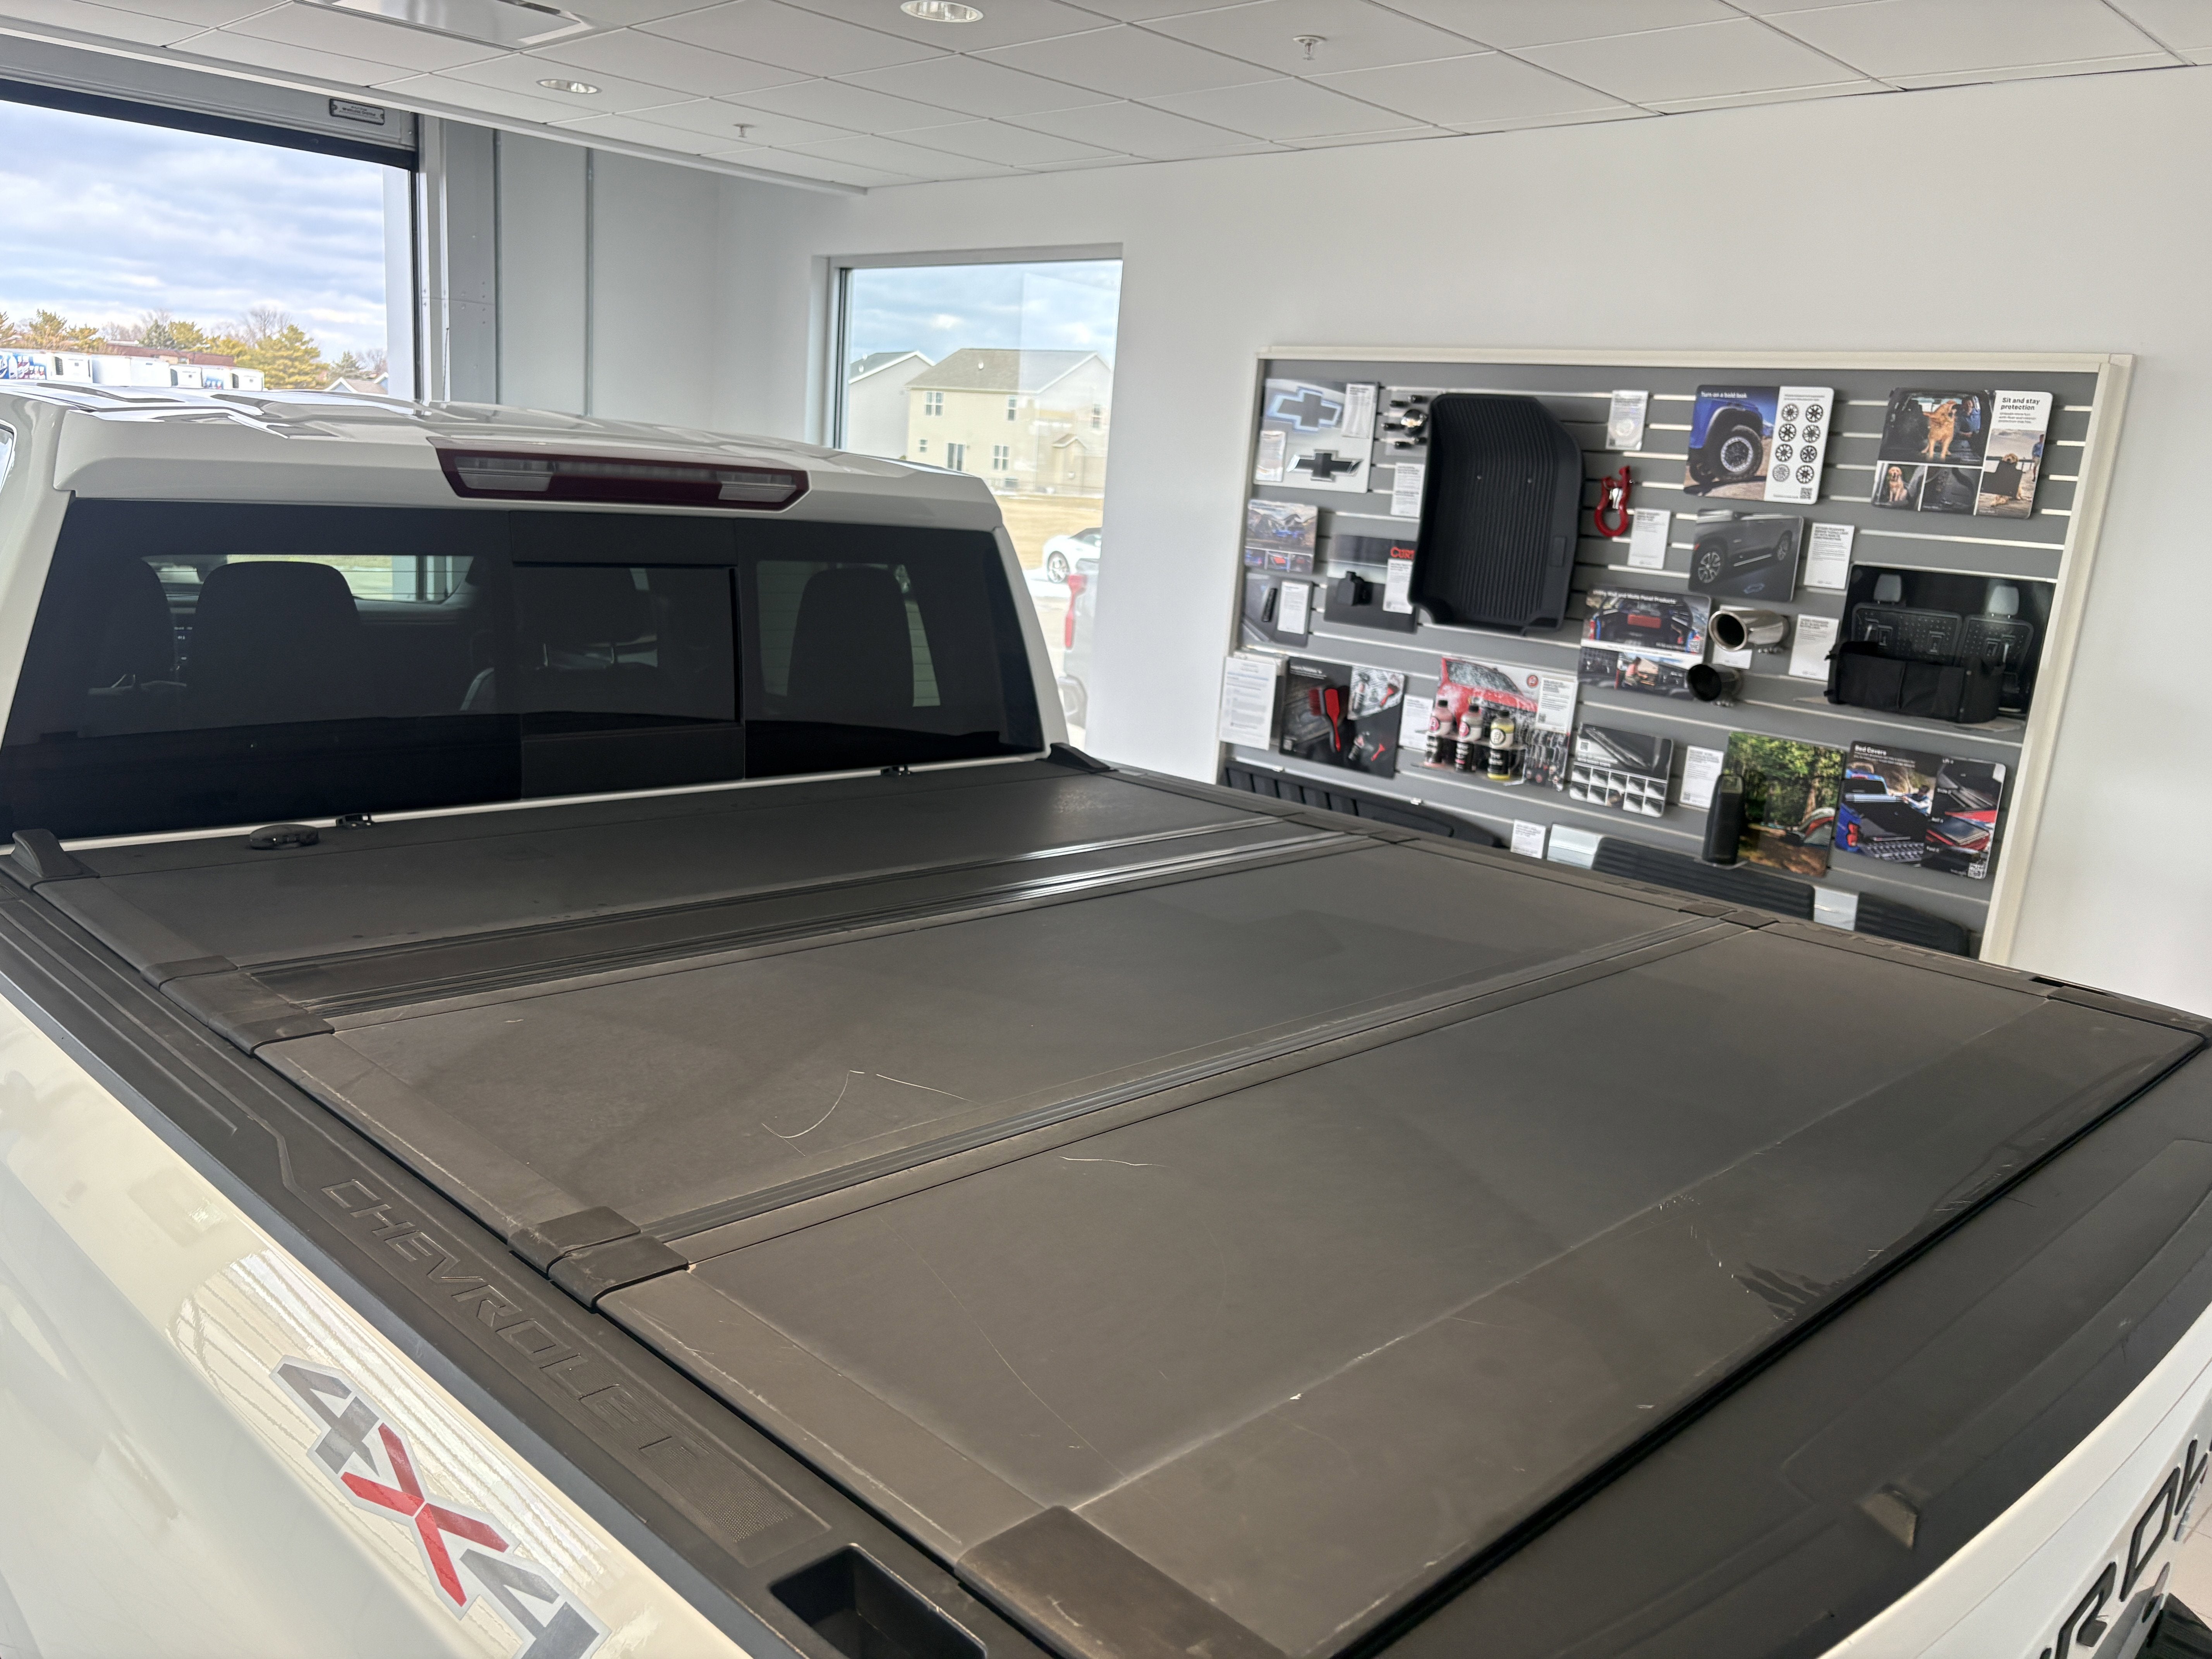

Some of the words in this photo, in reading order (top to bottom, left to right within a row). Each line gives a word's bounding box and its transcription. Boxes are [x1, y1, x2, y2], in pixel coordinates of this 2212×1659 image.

[1654, 596, 1676, 605] Products
[1855, 744, 1867, 753] Bed
[1867, 746, 1887, 756] Covers
[321, 1178, 709, 1460] CHEVROLET
[273, 1360, 604, 1659] 4X4
